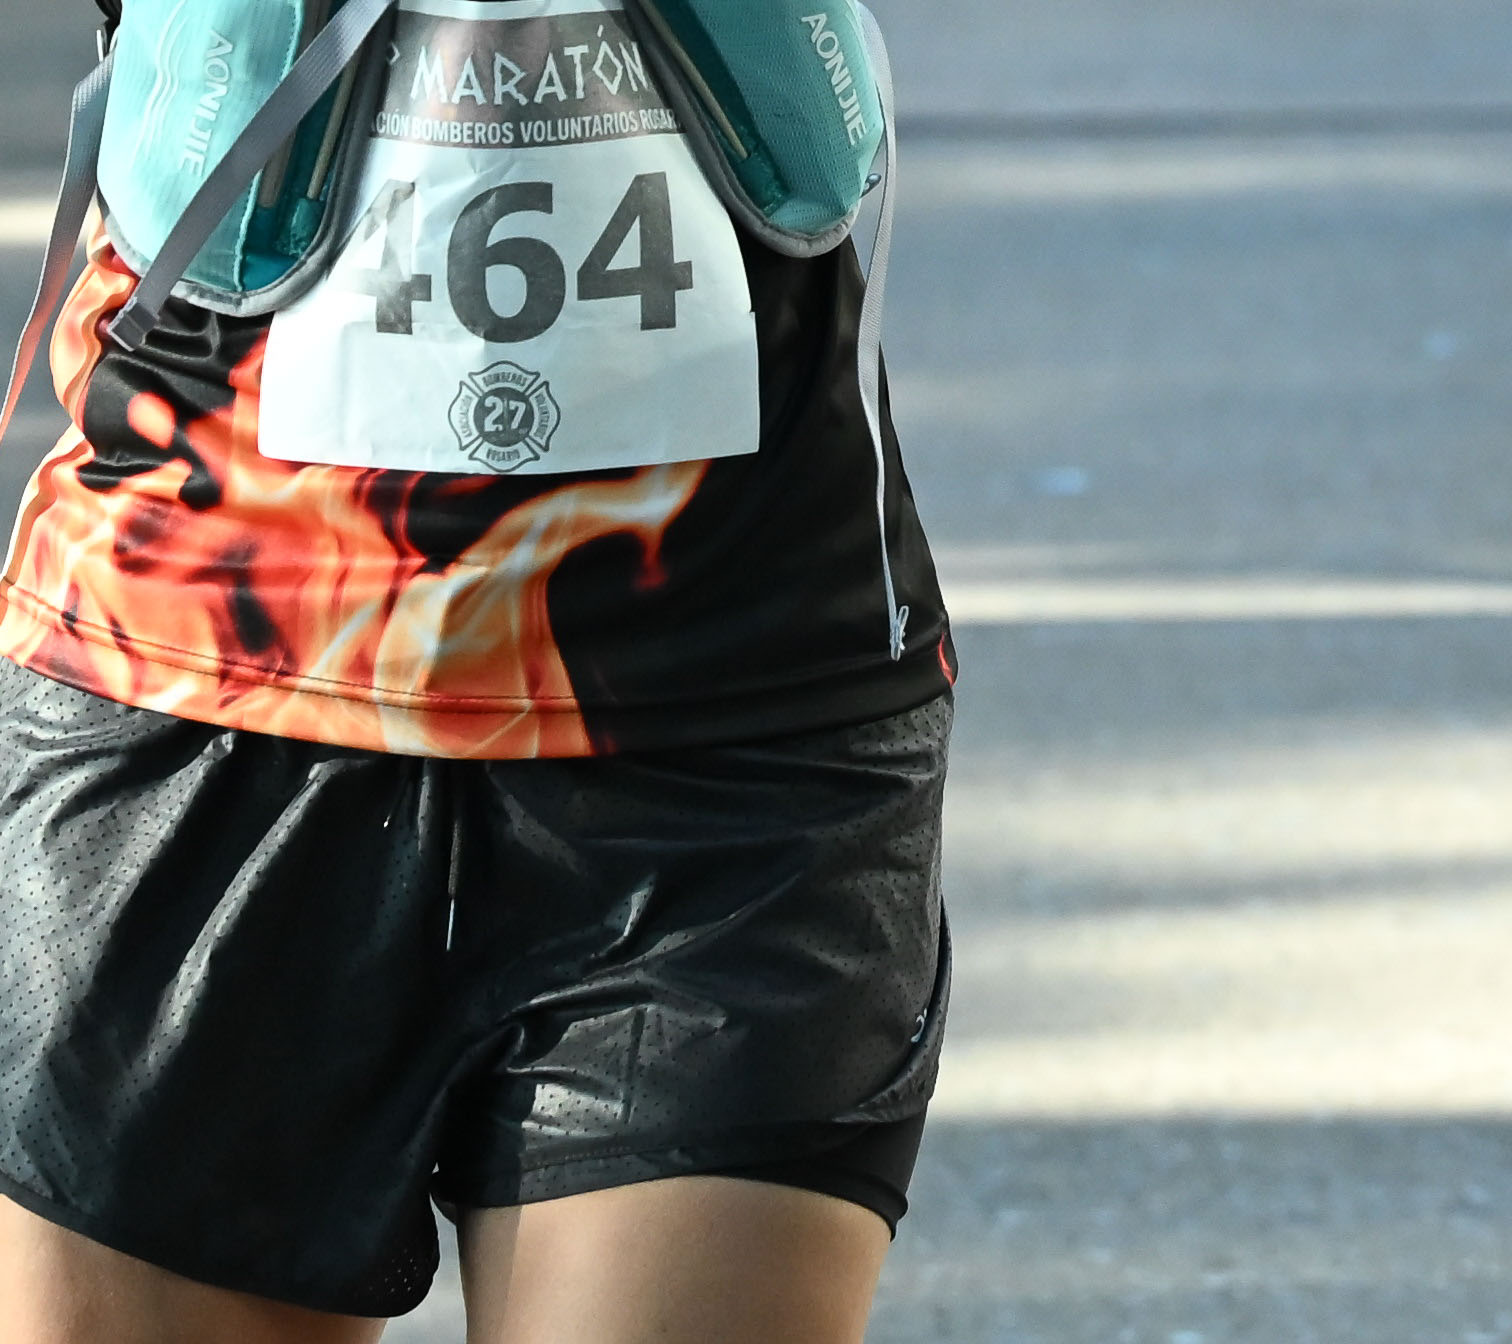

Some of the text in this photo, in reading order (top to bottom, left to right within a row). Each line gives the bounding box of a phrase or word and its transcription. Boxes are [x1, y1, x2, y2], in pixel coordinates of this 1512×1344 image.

[177, 29, 234, 178] AONIJIE
[409, 24, 649, 107] MARATÓN
[800, 12, 867, 146] AONIJIE
[372, 108, 410, 137] CIÓN
[411, 116, 515, 145] BOMBEROS
[519, 111, 639, 144] VOLUNTARIOS
[346, 171, 694, 344] 464
[483, 395, 527, 433] 27
